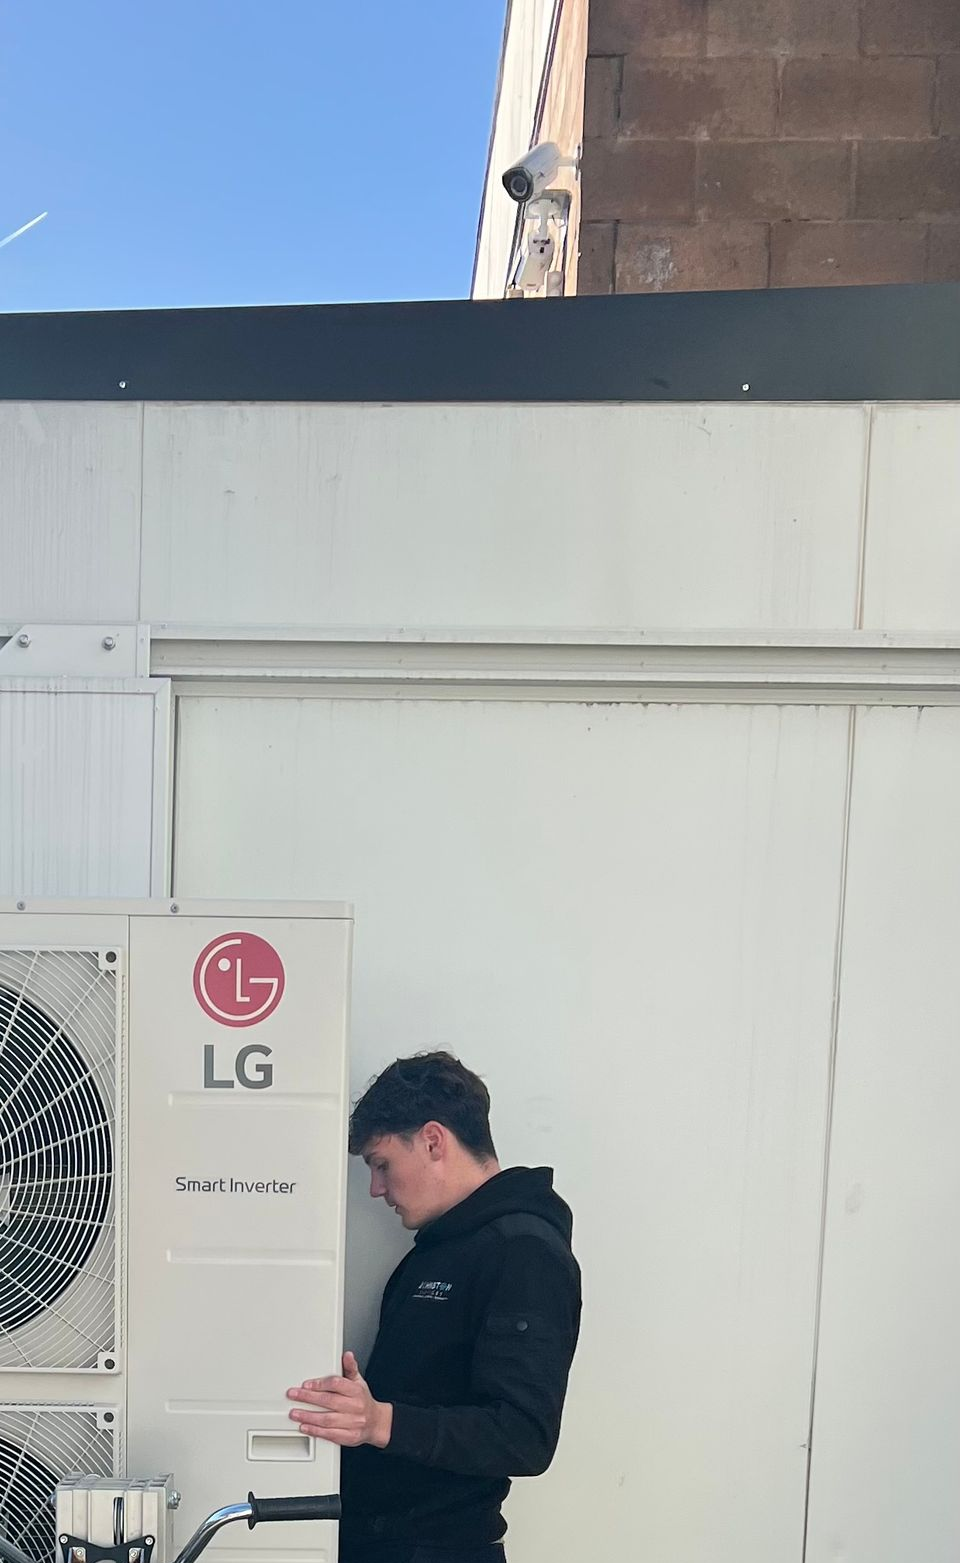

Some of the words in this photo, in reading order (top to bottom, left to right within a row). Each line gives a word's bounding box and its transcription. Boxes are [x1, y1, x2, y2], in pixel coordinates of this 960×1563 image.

[203, 1044, 274, 1089] LG
[175, 1177, 226, 1192] Smart
[230, 1178, 297, 1194] Inverter
